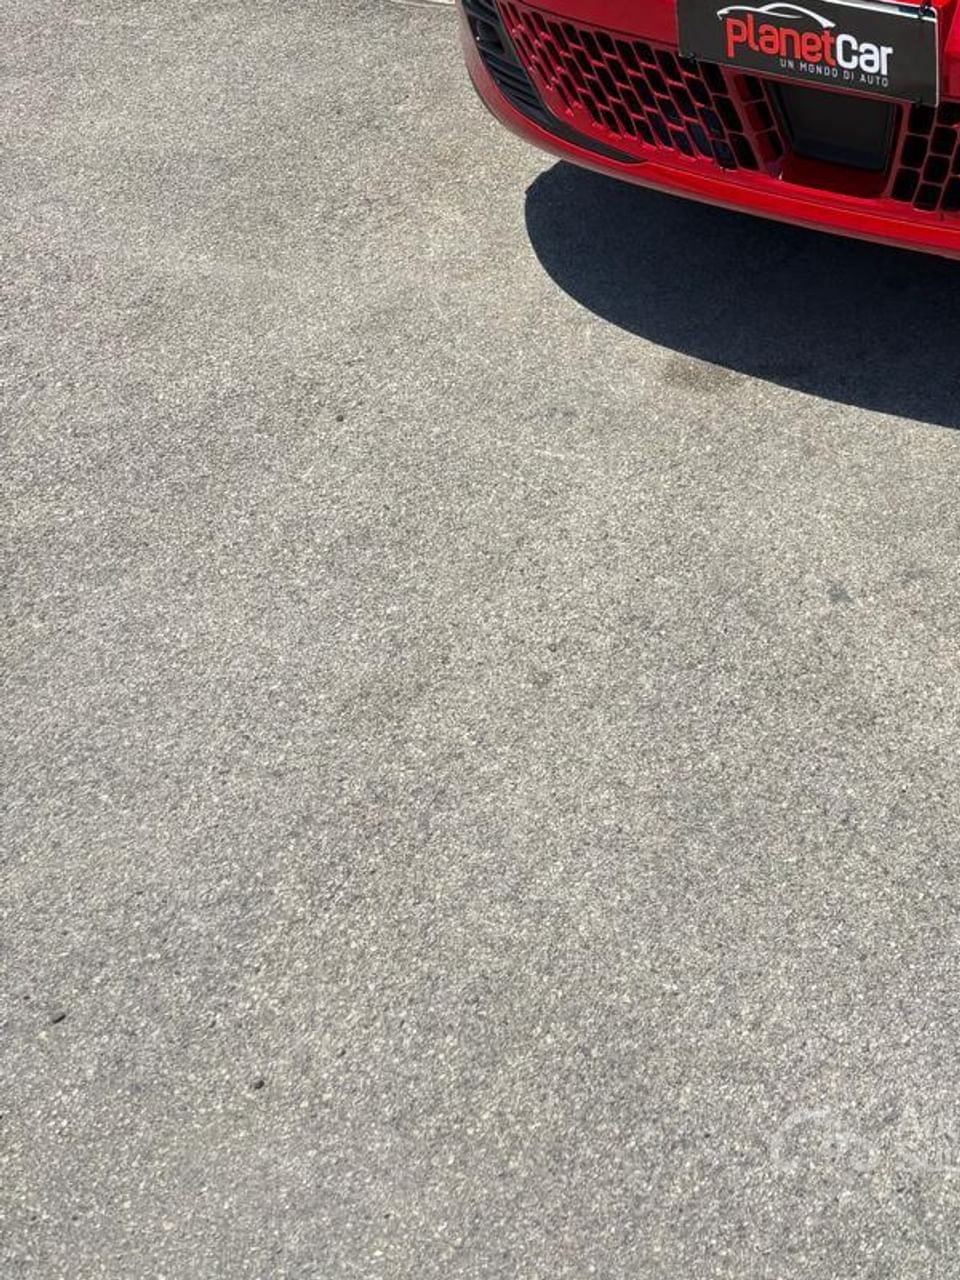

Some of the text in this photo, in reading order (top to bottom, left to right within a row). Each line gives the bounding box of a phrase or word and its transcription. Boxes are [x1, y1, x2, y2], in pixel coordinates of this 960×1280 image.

[725, 12, 894, 76] planetCar
[780, 58, 888, 88] UN MONDO DI AUTO
